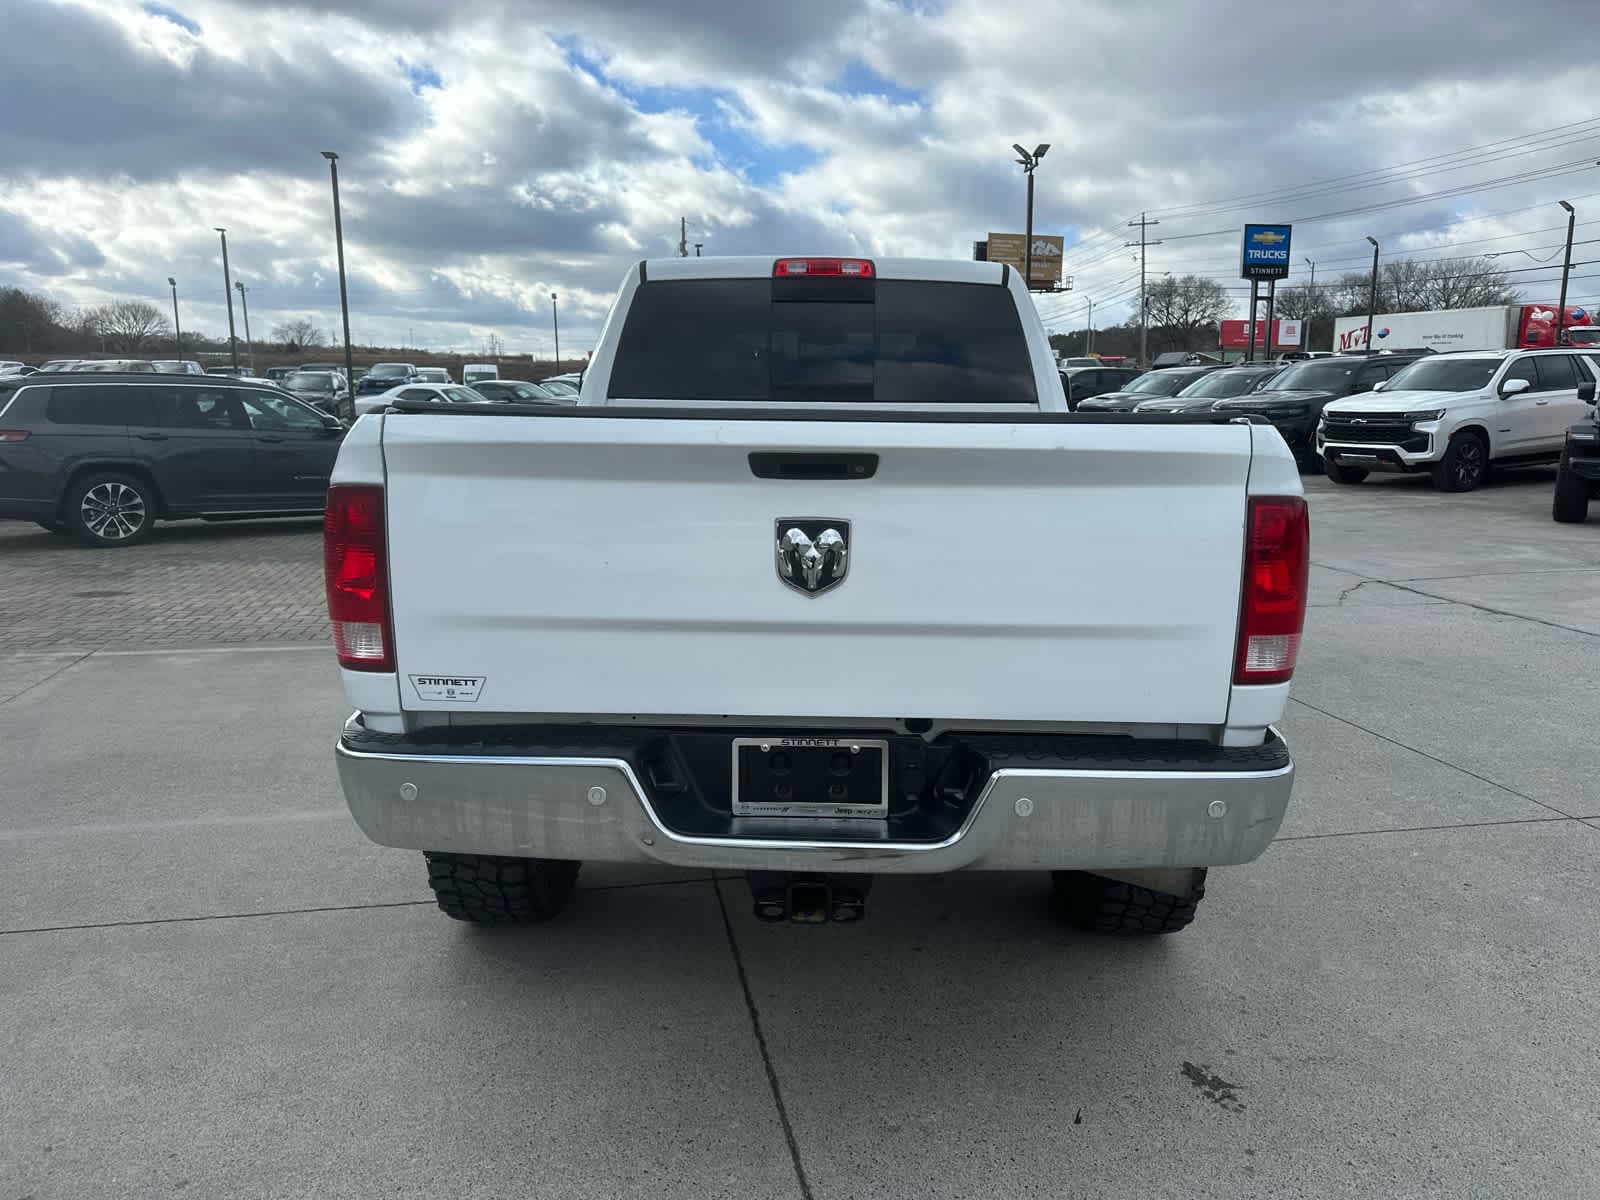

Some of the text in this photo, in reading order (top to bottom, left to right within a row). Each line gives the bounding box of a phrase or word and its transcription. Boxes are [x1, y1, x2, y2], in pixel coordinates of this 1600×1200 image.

[1248, 249, 1288, 259] TRUCKS
[1250, 267, 1283, 275] STINNETT
[417, 677, 478, 687] STINNETT
[781, 738, 840, 747] STINNETT
